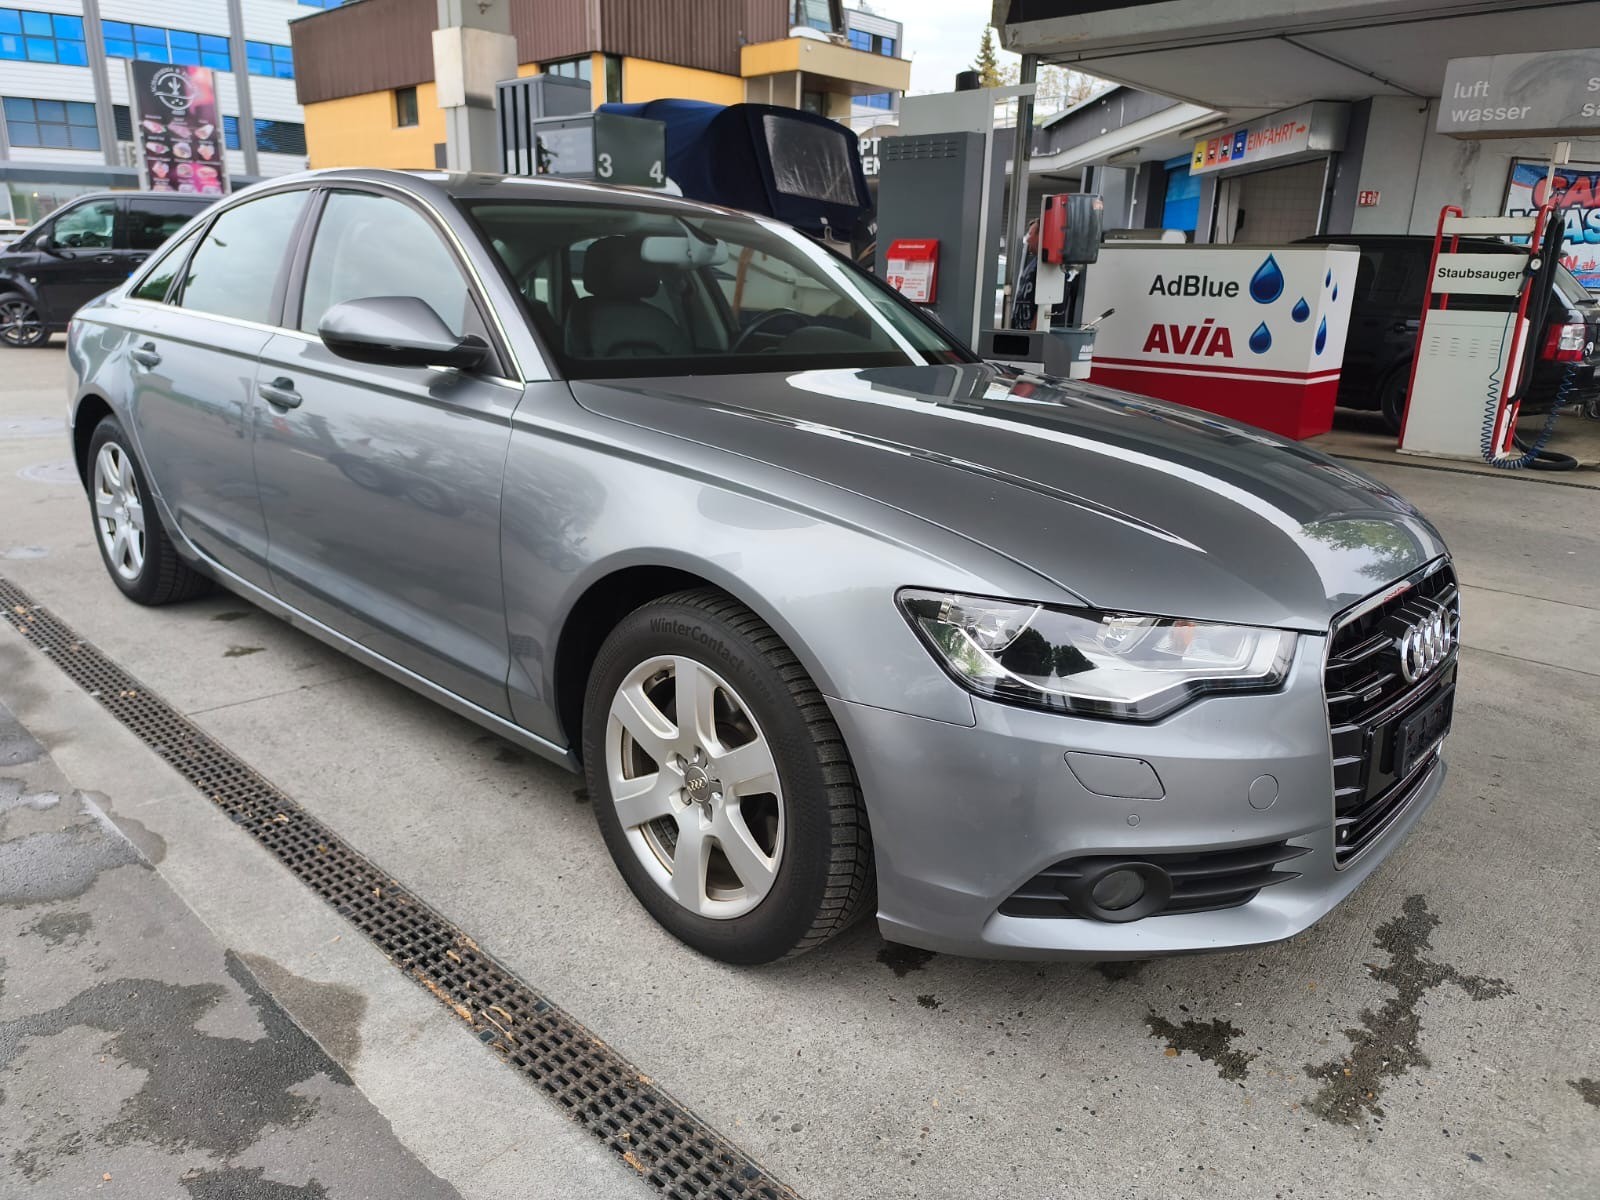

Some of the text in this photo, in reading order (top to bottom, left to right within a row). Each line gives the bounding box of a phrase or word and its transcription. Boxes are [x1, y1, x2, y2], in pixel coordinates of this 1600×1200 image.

[1453, 80, 1490, 99] luft
[1452, 105, 1532, 122] wasser
[1247, 121, 1297, 151] EINFAHRT
[598, 152, 613, 178] 3
[649, 160, 664, 183] 4
[1531, 174, 1600, 210] CA
[1148, 274, 1240, 298] AdBlue
[1437, 266, 1522, 282] Staubsauger
[649, 616, 746, 673] WinterContact
